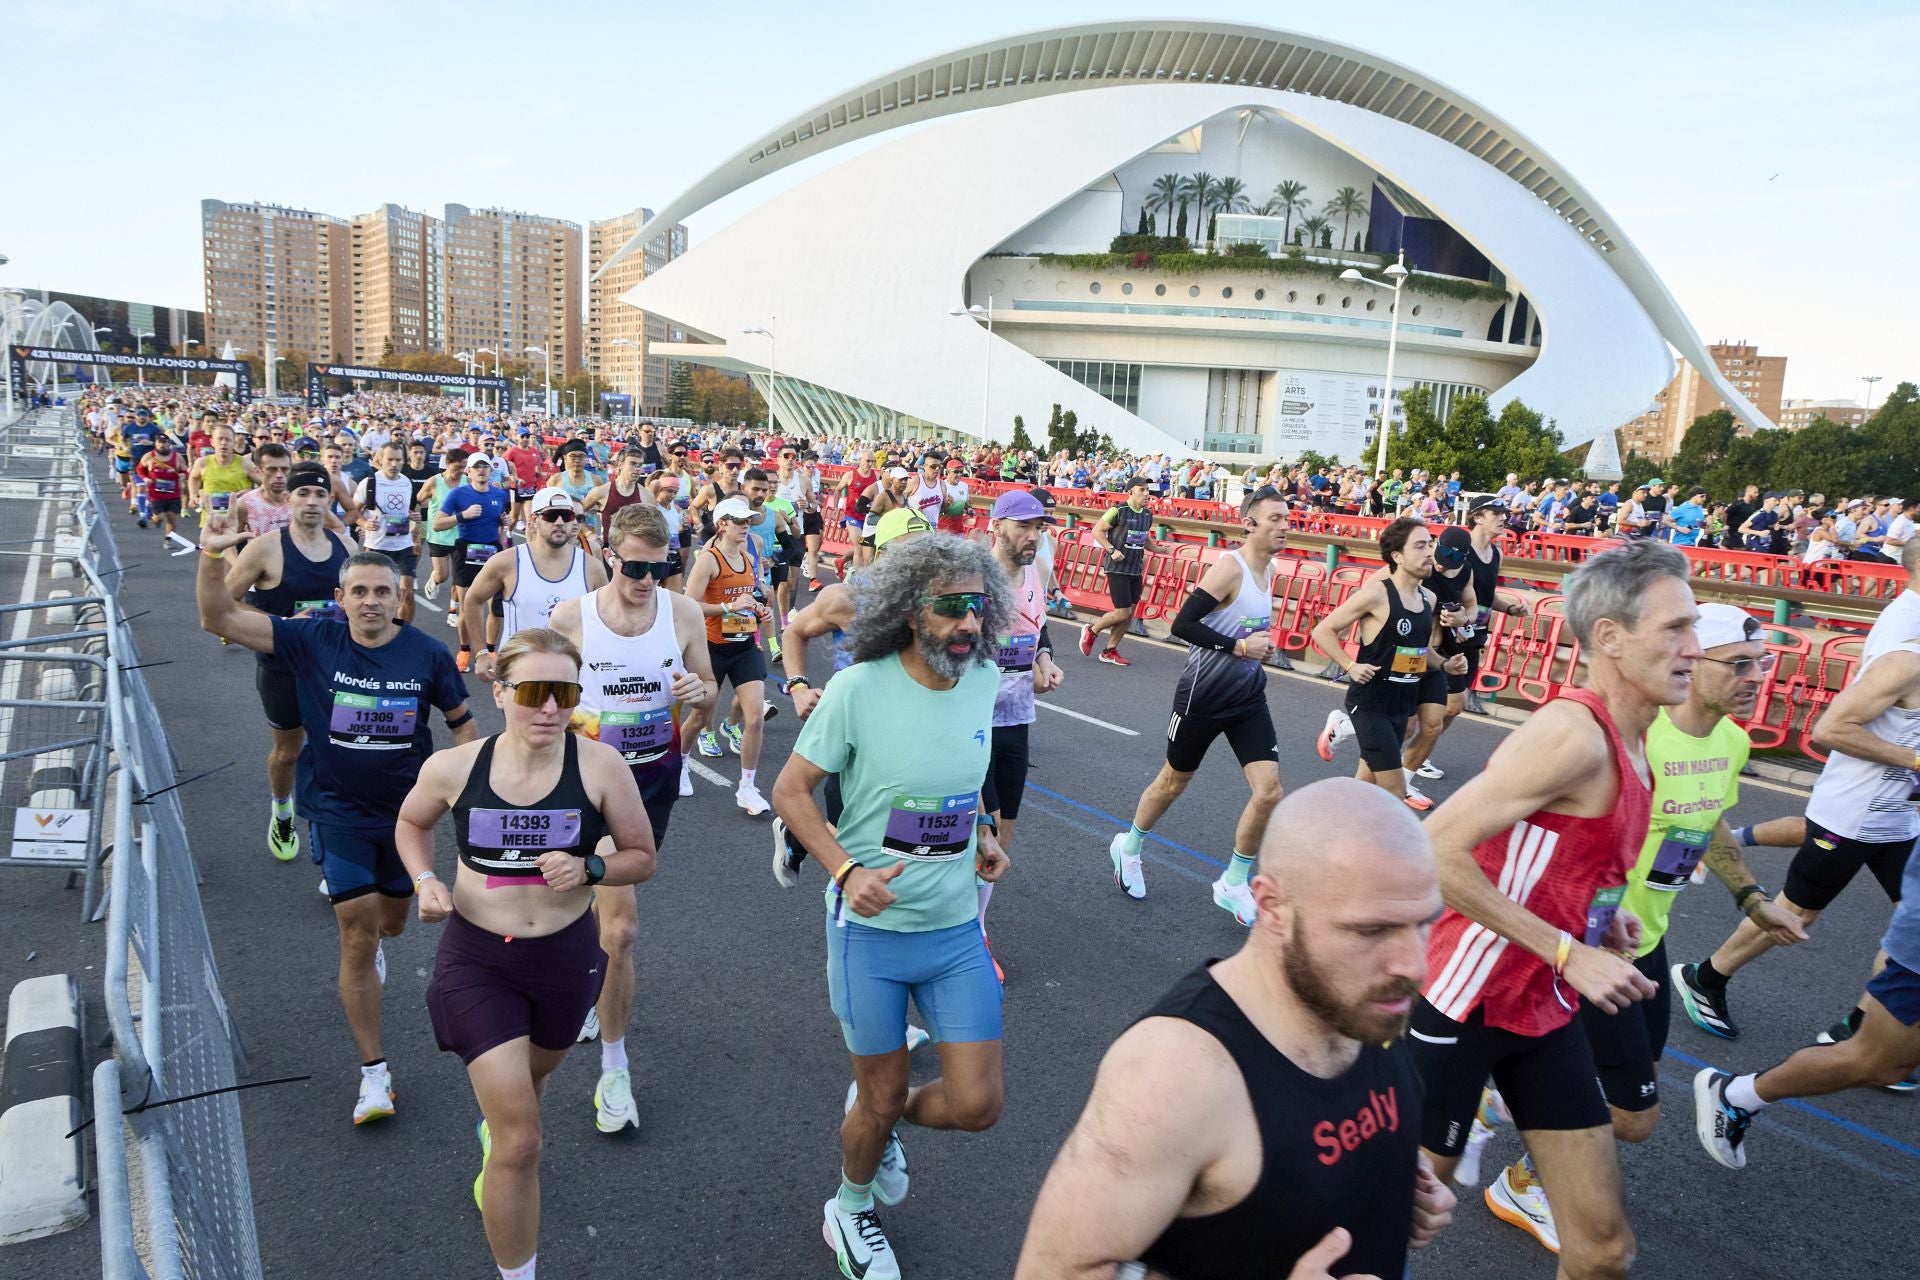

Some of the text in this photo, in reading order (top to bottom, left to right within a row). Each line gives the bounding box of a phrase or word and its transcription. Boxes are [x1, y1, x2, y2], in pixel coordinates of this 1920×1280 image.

[31, 350, 50, 359] 42K
[50, 351, 93, 361] VALENCIA
[94, 354, 149, 365] TRINIDAD
[146, 358, 195, 369] ALFONSO
[328, 367, 343, 375] 42K
[344, 368, 380, 378] VALENCIA
[381, 371, 423, 382] TRINIDAD
[424, 374, 466, 385] ALFONSO
[1284, 386, 1306, 395] ARTS
[334, 671, 380, 690] Nordés
[603, 681, 662, 696] MARATHON
[355, 711, 394, 722] 11309
[347, 724, 399, 734] JOSE MAN
[621, 725, 656, 738] 13322
[621, 739, 656, 750] Thomas
[1664, 757, 1728, 776] SEMI MARATHON
[500, 815, 550, 829] 14393
[918, 814, 958, 828] 11532
[502, 834, 547, 846] MEEEE
[921, 832, 950, 843] Omid
[1313, 1086, 1399, 1166] Sealy
[1714, 1109, 1724, 1138] HOKA
